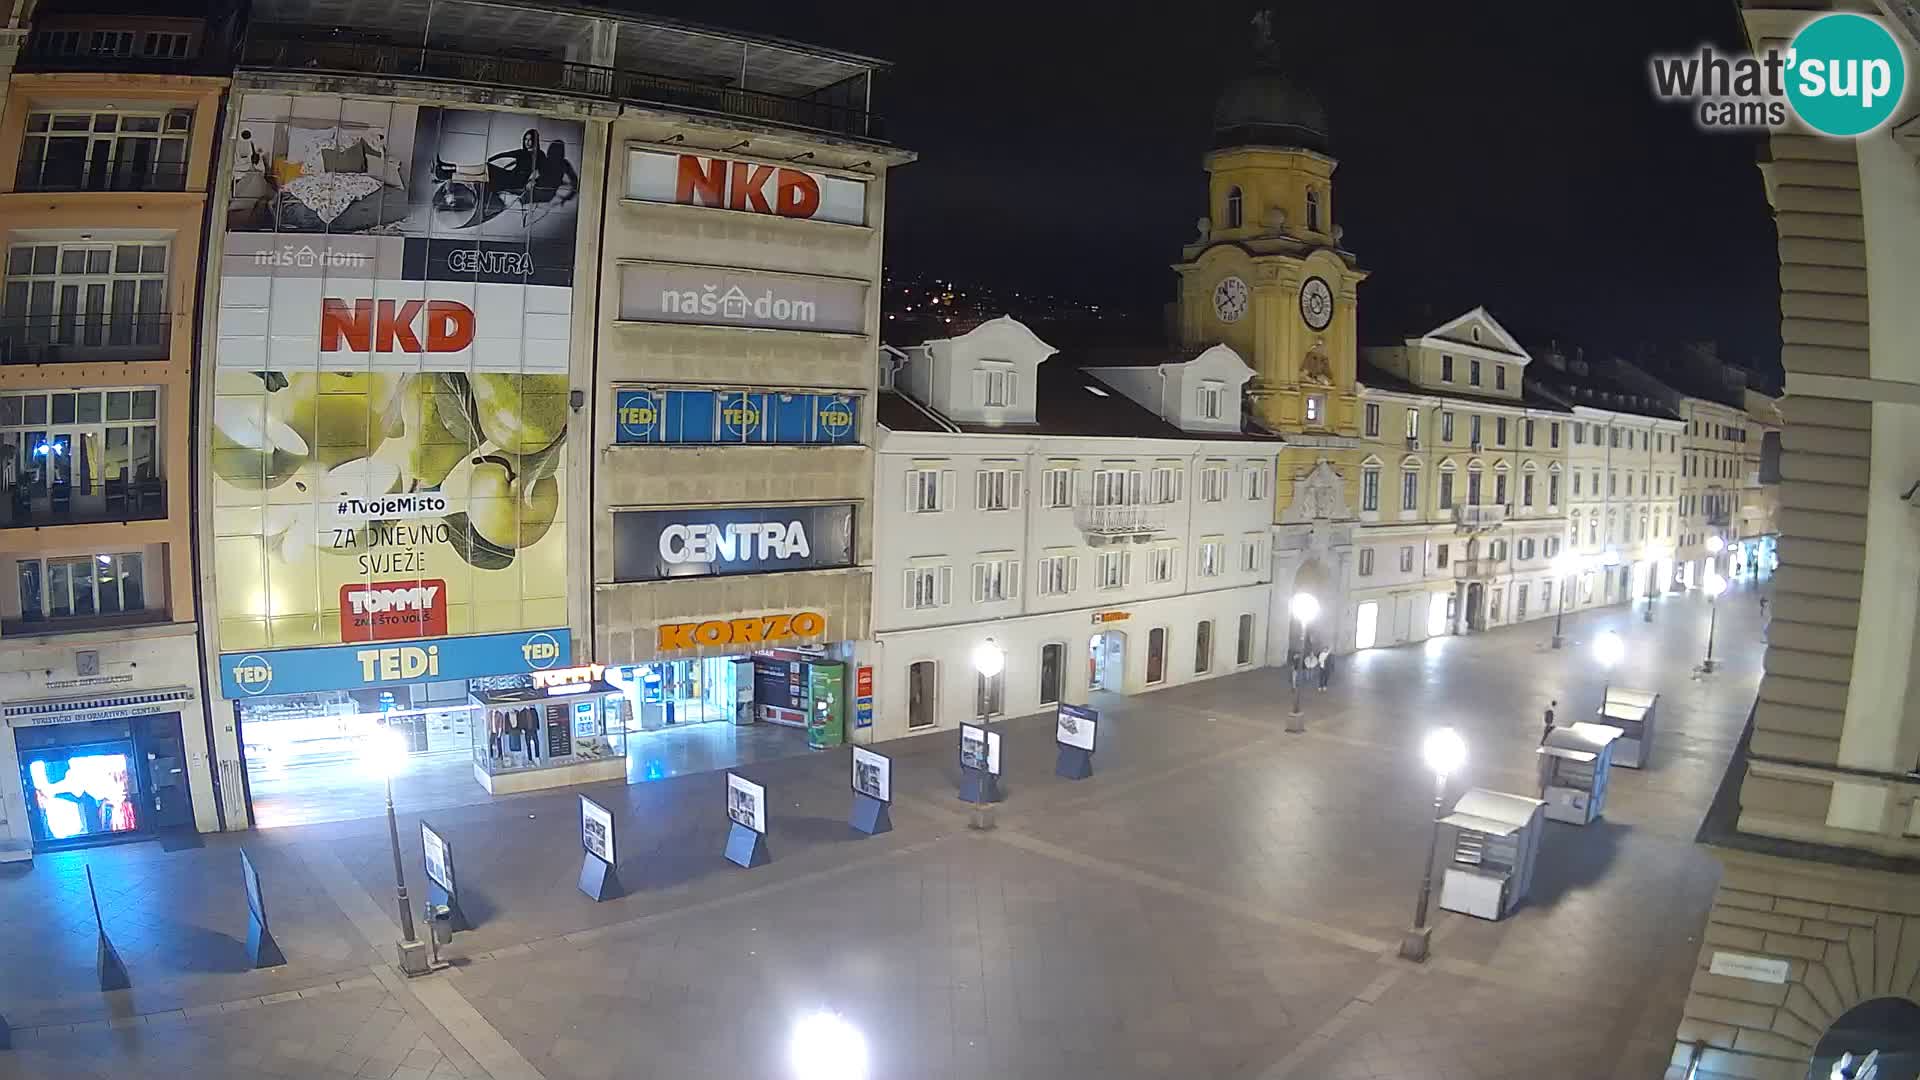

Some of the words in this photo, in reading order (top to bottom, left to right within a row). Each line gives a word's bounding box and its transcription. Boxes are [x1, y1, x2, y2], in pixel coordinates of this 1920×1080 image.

[676, 154, 820, 219] NKD
[254, 244, 295, 267] naš
[318, 245, 367, 269] dom
[446, 248, 535, 276] CENTRA
[661, 283, 717, 315] naš
[754, 289, 816, 322] dom
[319, 297, 477, 353] NKD
[619, 407, 657, 425] TEDi
[338, 496, 446, 517] #TvojeMisto
[333, 528, 357, 549] ZA
[367, 523, 450, 548] DNEVNO
[659, 521, 809, 563] CENTRA
[359, 547, 425, 575] SVJEŽE
[348, 586, 439, 615] TOMMY
[659, 612, 825, 651] KORZO
[357, 645, 439, 682] TEDi
[522, 643, 560, 660] TEDi
[232, 664, 273, 684] TEDi
